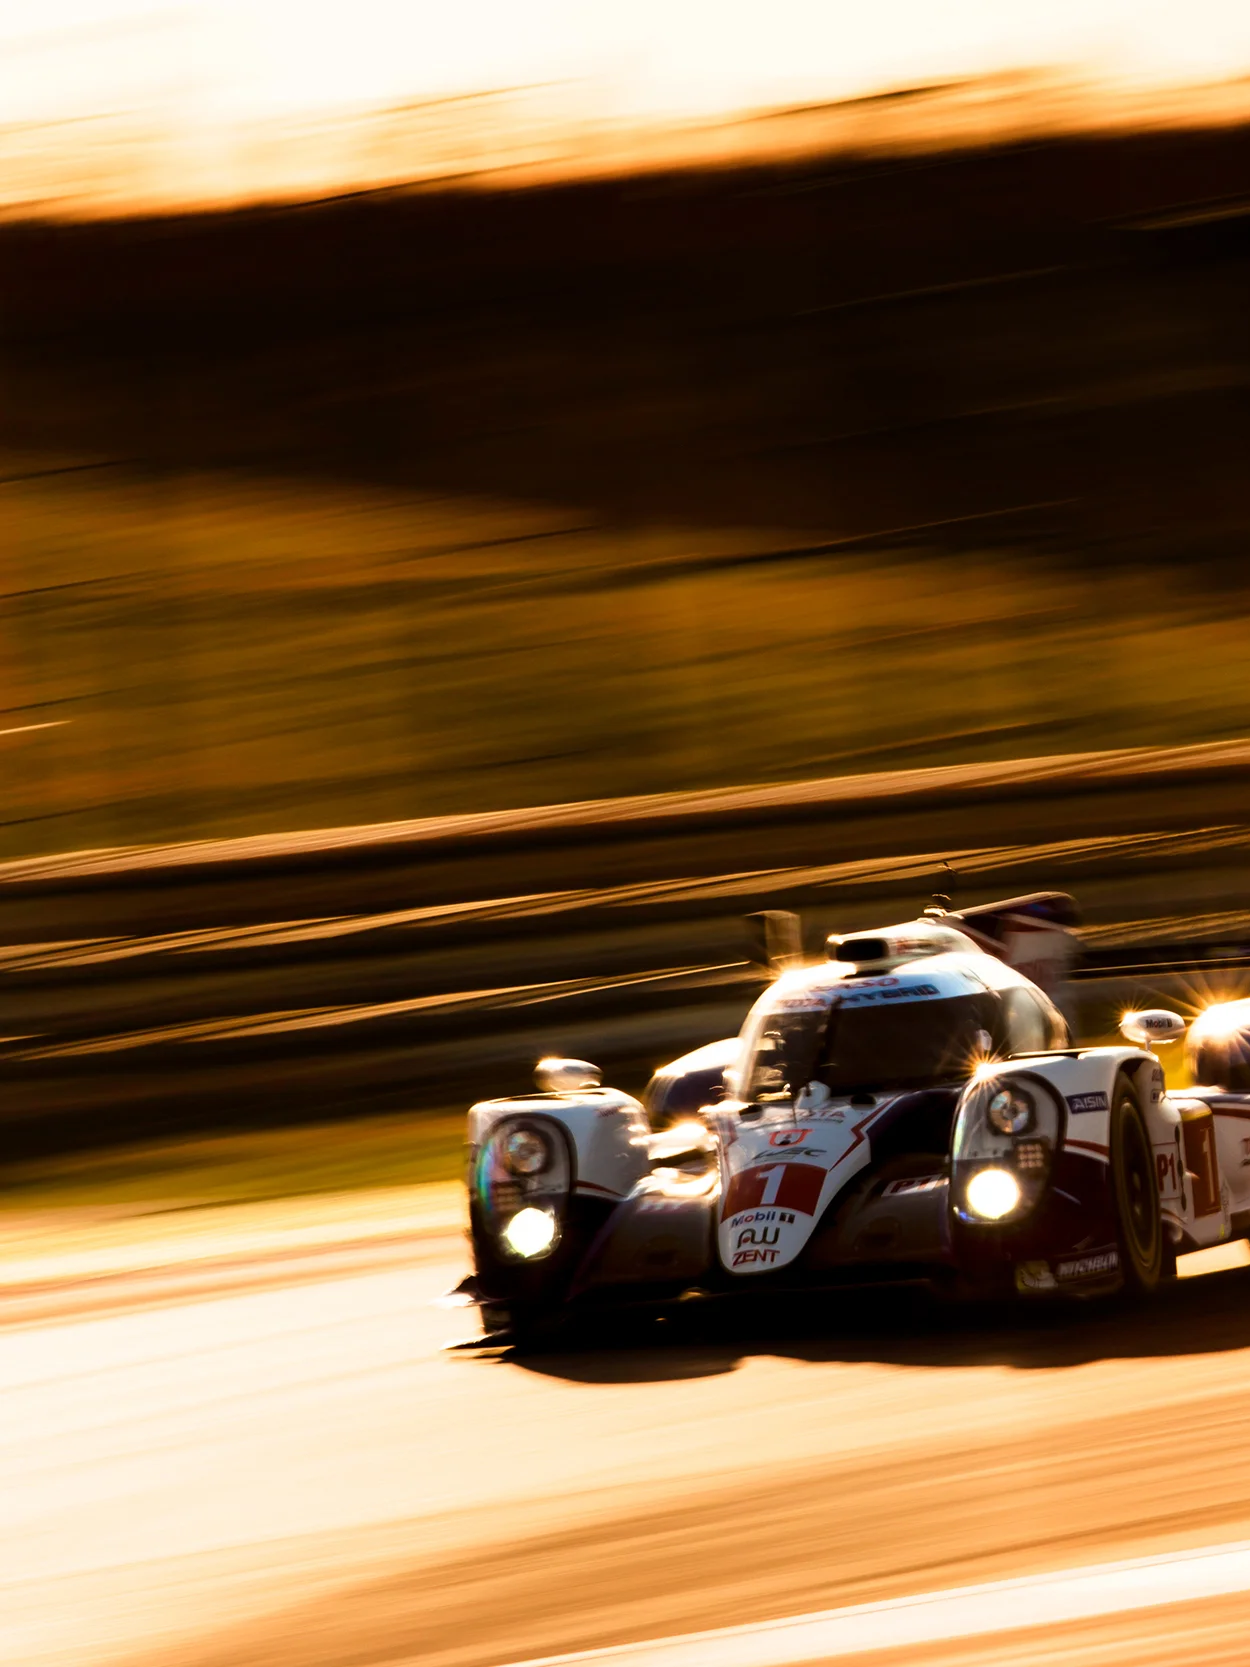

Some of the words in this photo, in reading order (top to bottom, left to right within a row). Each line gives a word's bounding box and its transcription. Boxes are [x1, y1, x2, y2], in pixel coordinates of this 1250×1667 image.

[1072, 1095, 1108, 1109] AISIN
[1156, 1152, 1177, 1192] P1
[1202, 1127, 1216, 1204] 1
[757, 1164, 787, 1205] 1
[731, 1211, 776, 1227] Mobil
[732, 1249, 780, 1267] ZENT
